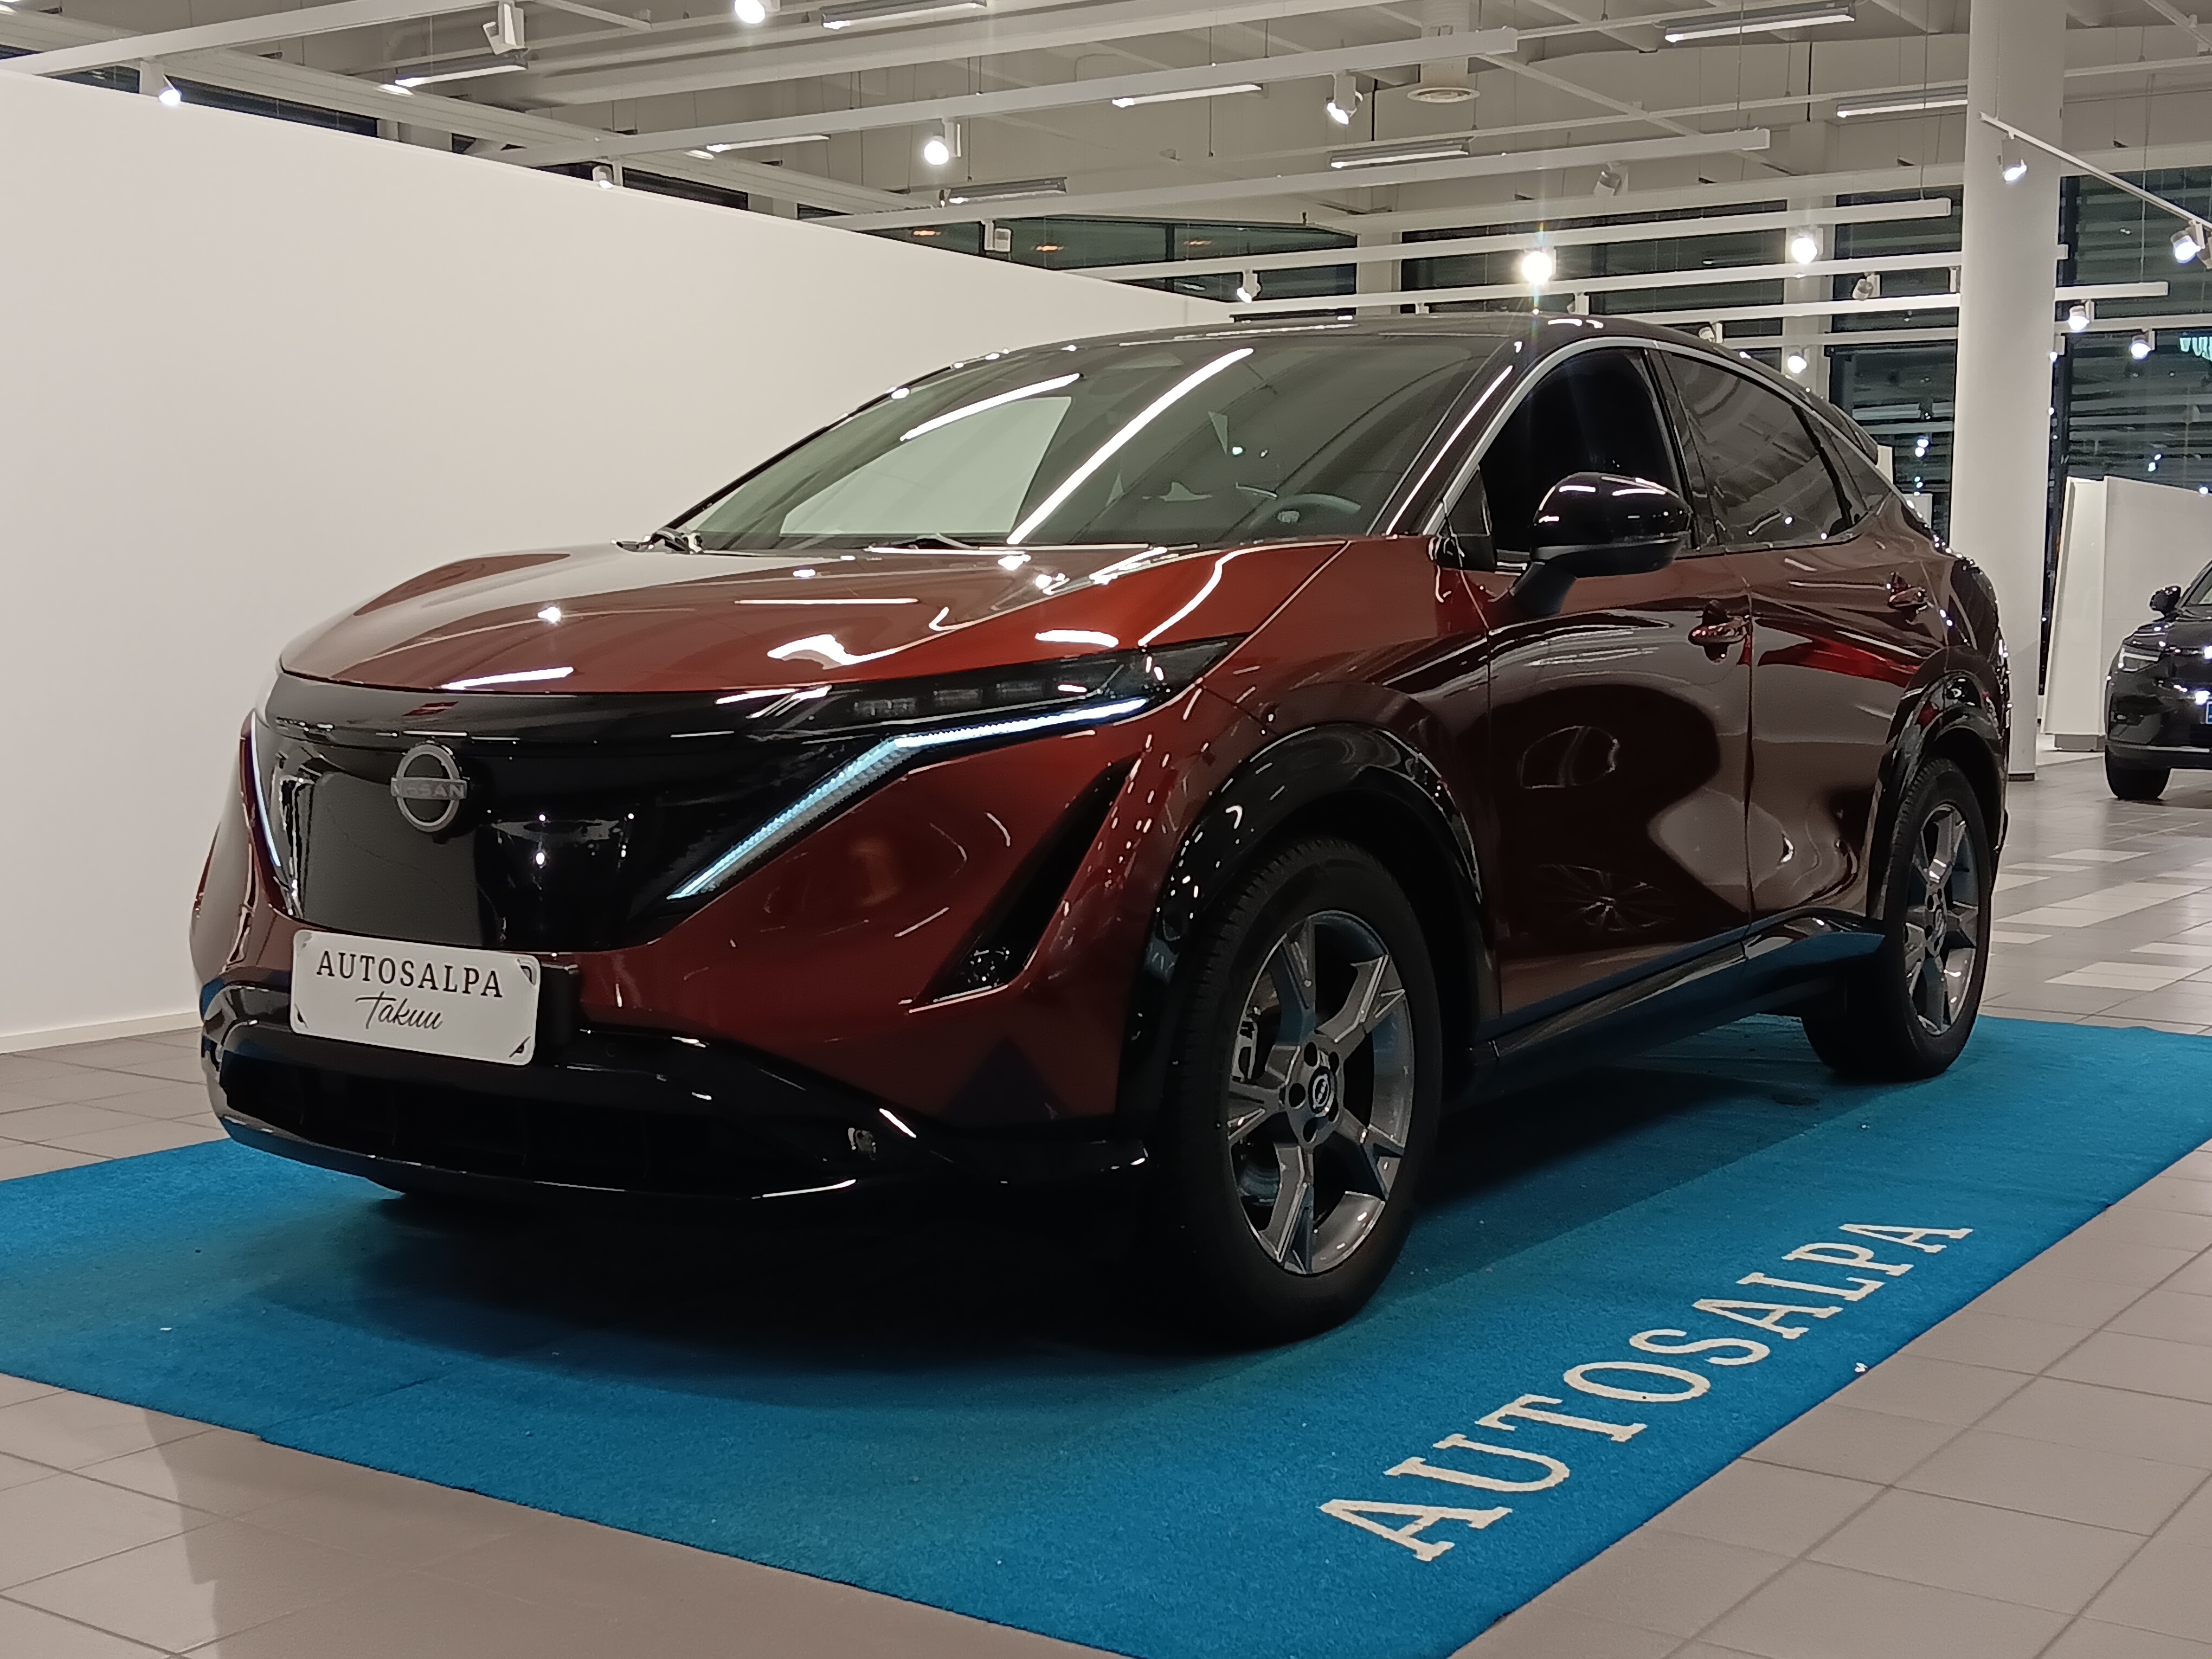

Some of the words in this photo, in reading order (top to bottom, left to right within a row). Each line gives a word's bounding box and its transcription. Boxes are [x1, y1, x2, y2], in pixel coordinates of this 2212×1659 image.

[316, 950, 503, 998] AUTOSALPA
[355, 991, 444, 1030] Takuu
[1320, 1223, 1973, 1561] AUTOSALPA
